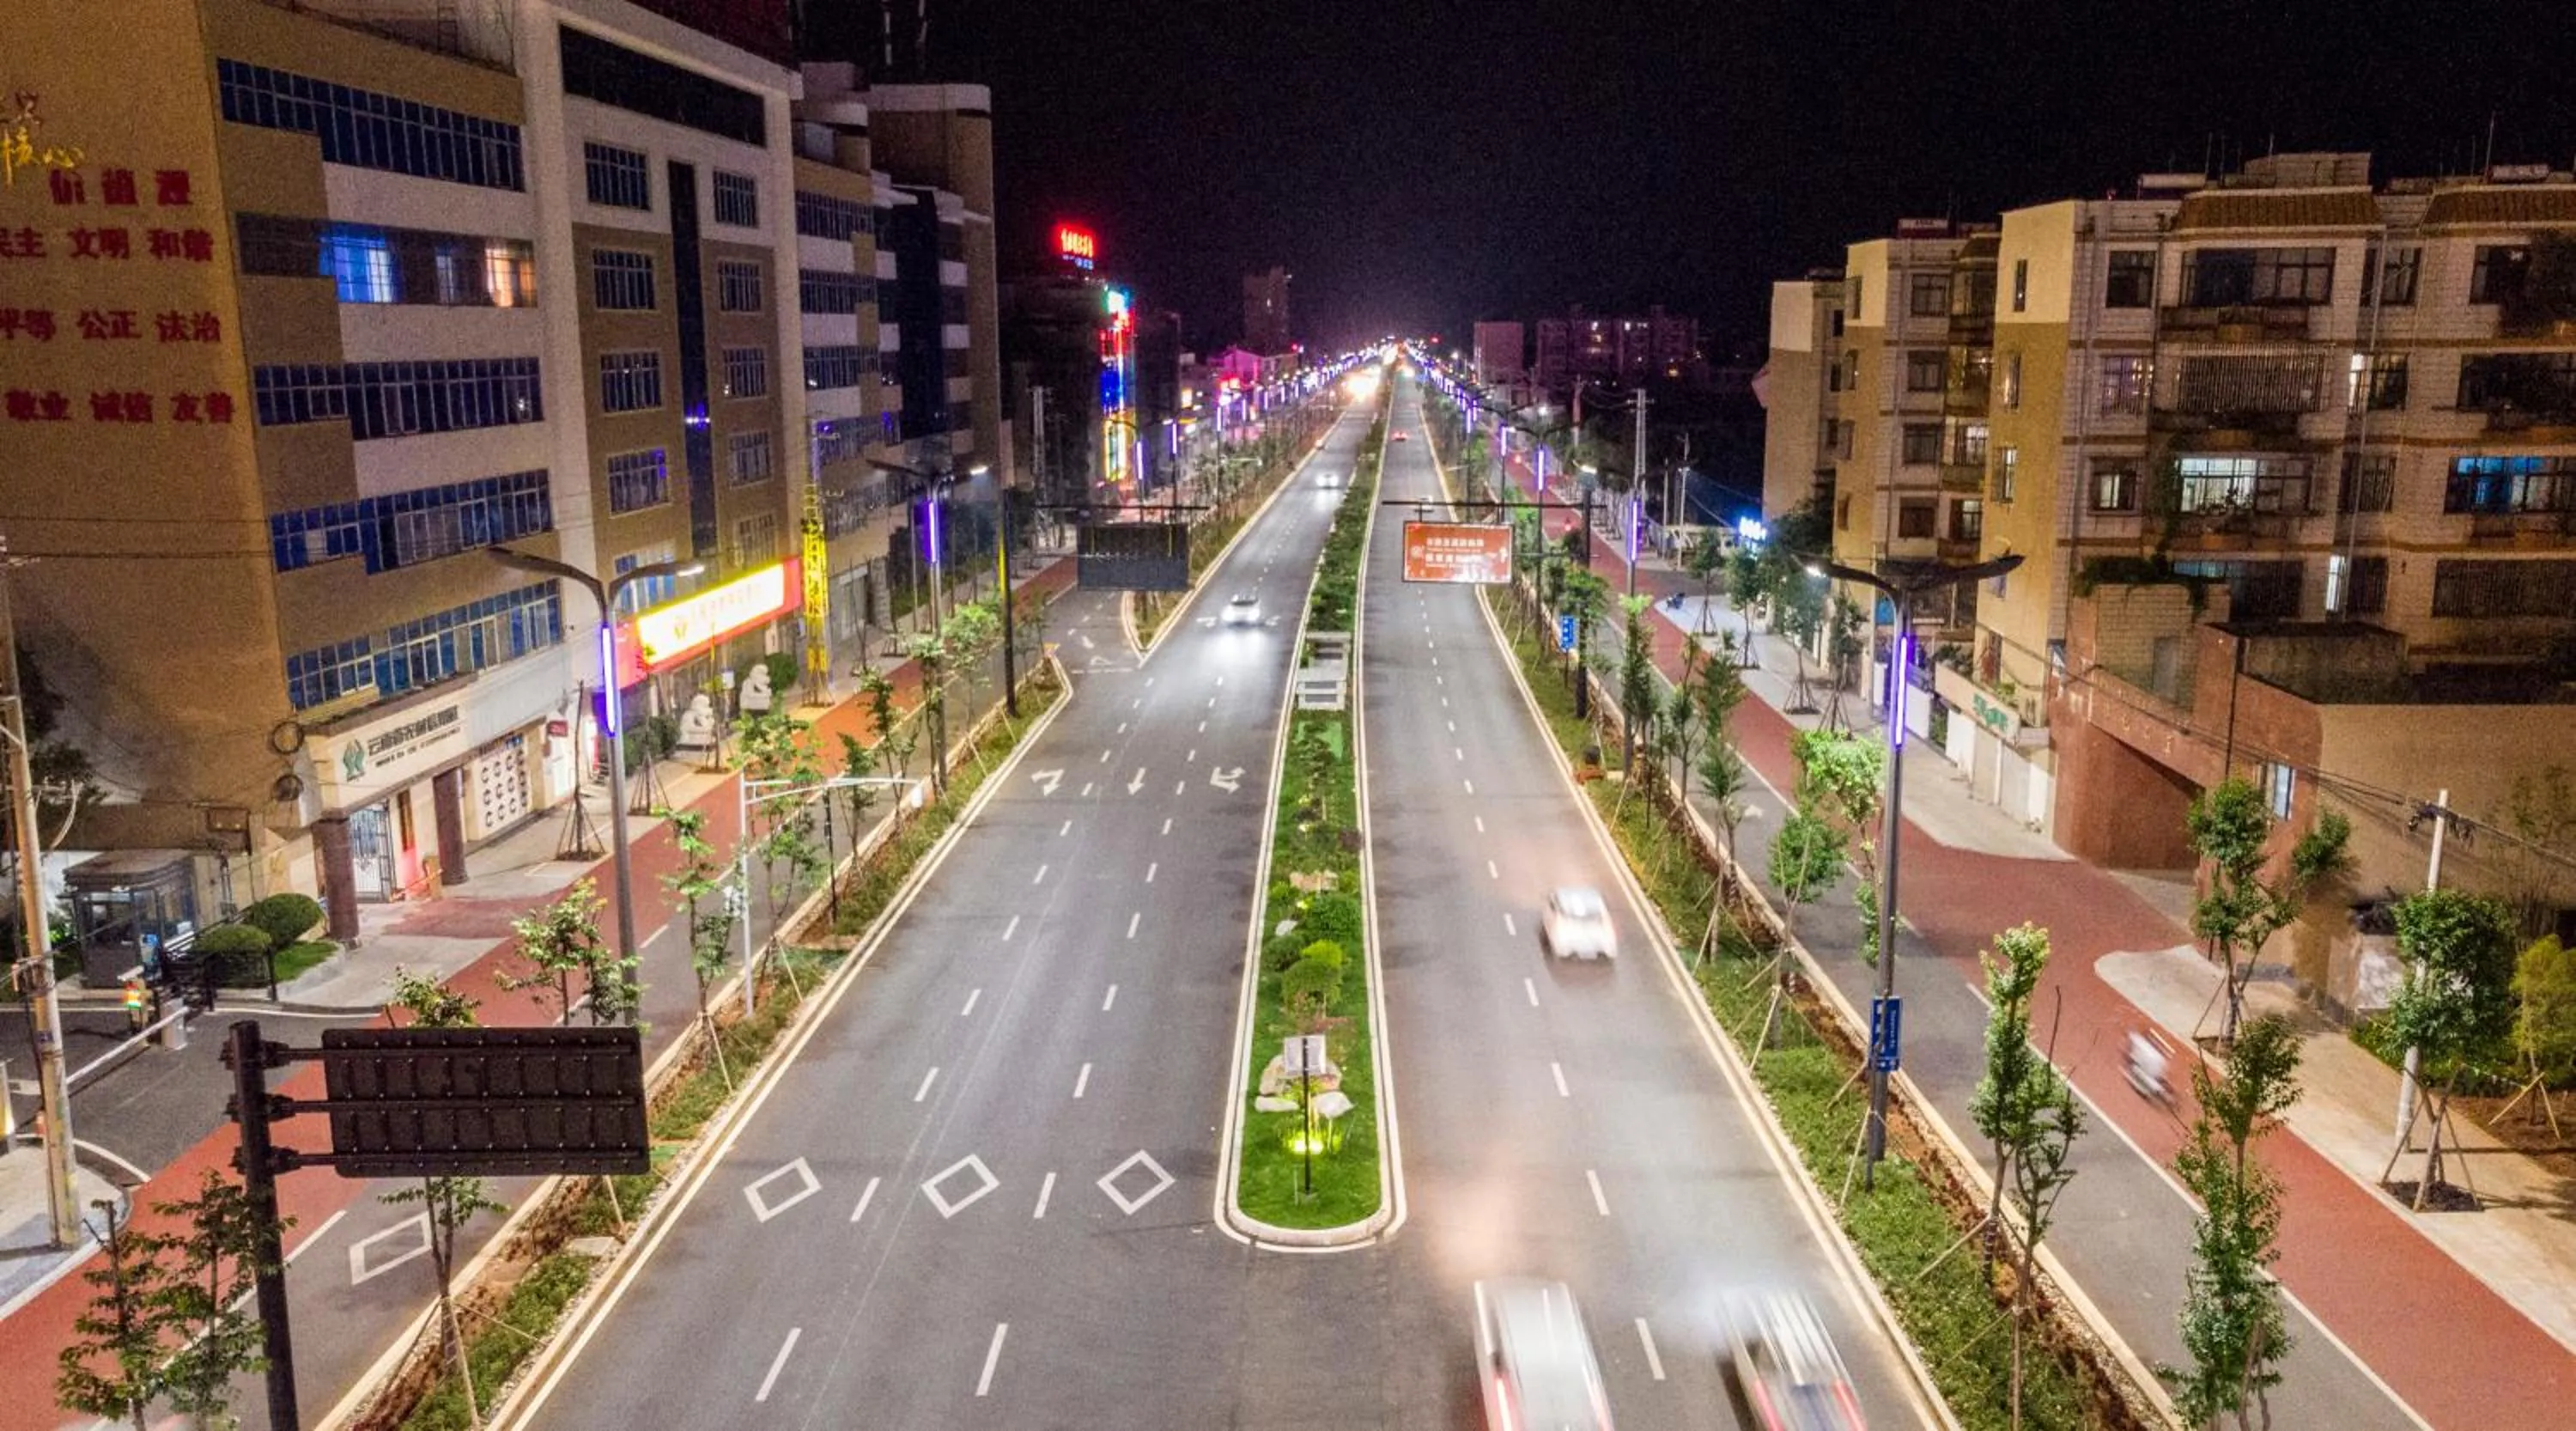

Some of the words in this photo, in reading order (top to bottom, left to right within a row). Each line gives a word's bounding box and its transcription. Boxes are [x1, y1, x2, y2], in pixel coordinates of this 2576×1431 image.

[67, 227, 130, 259] 文明
[76, 309, 142, 339] 公正
[155, 310, 222, 342] 法治
[171, 390, 234, 425] 友善
